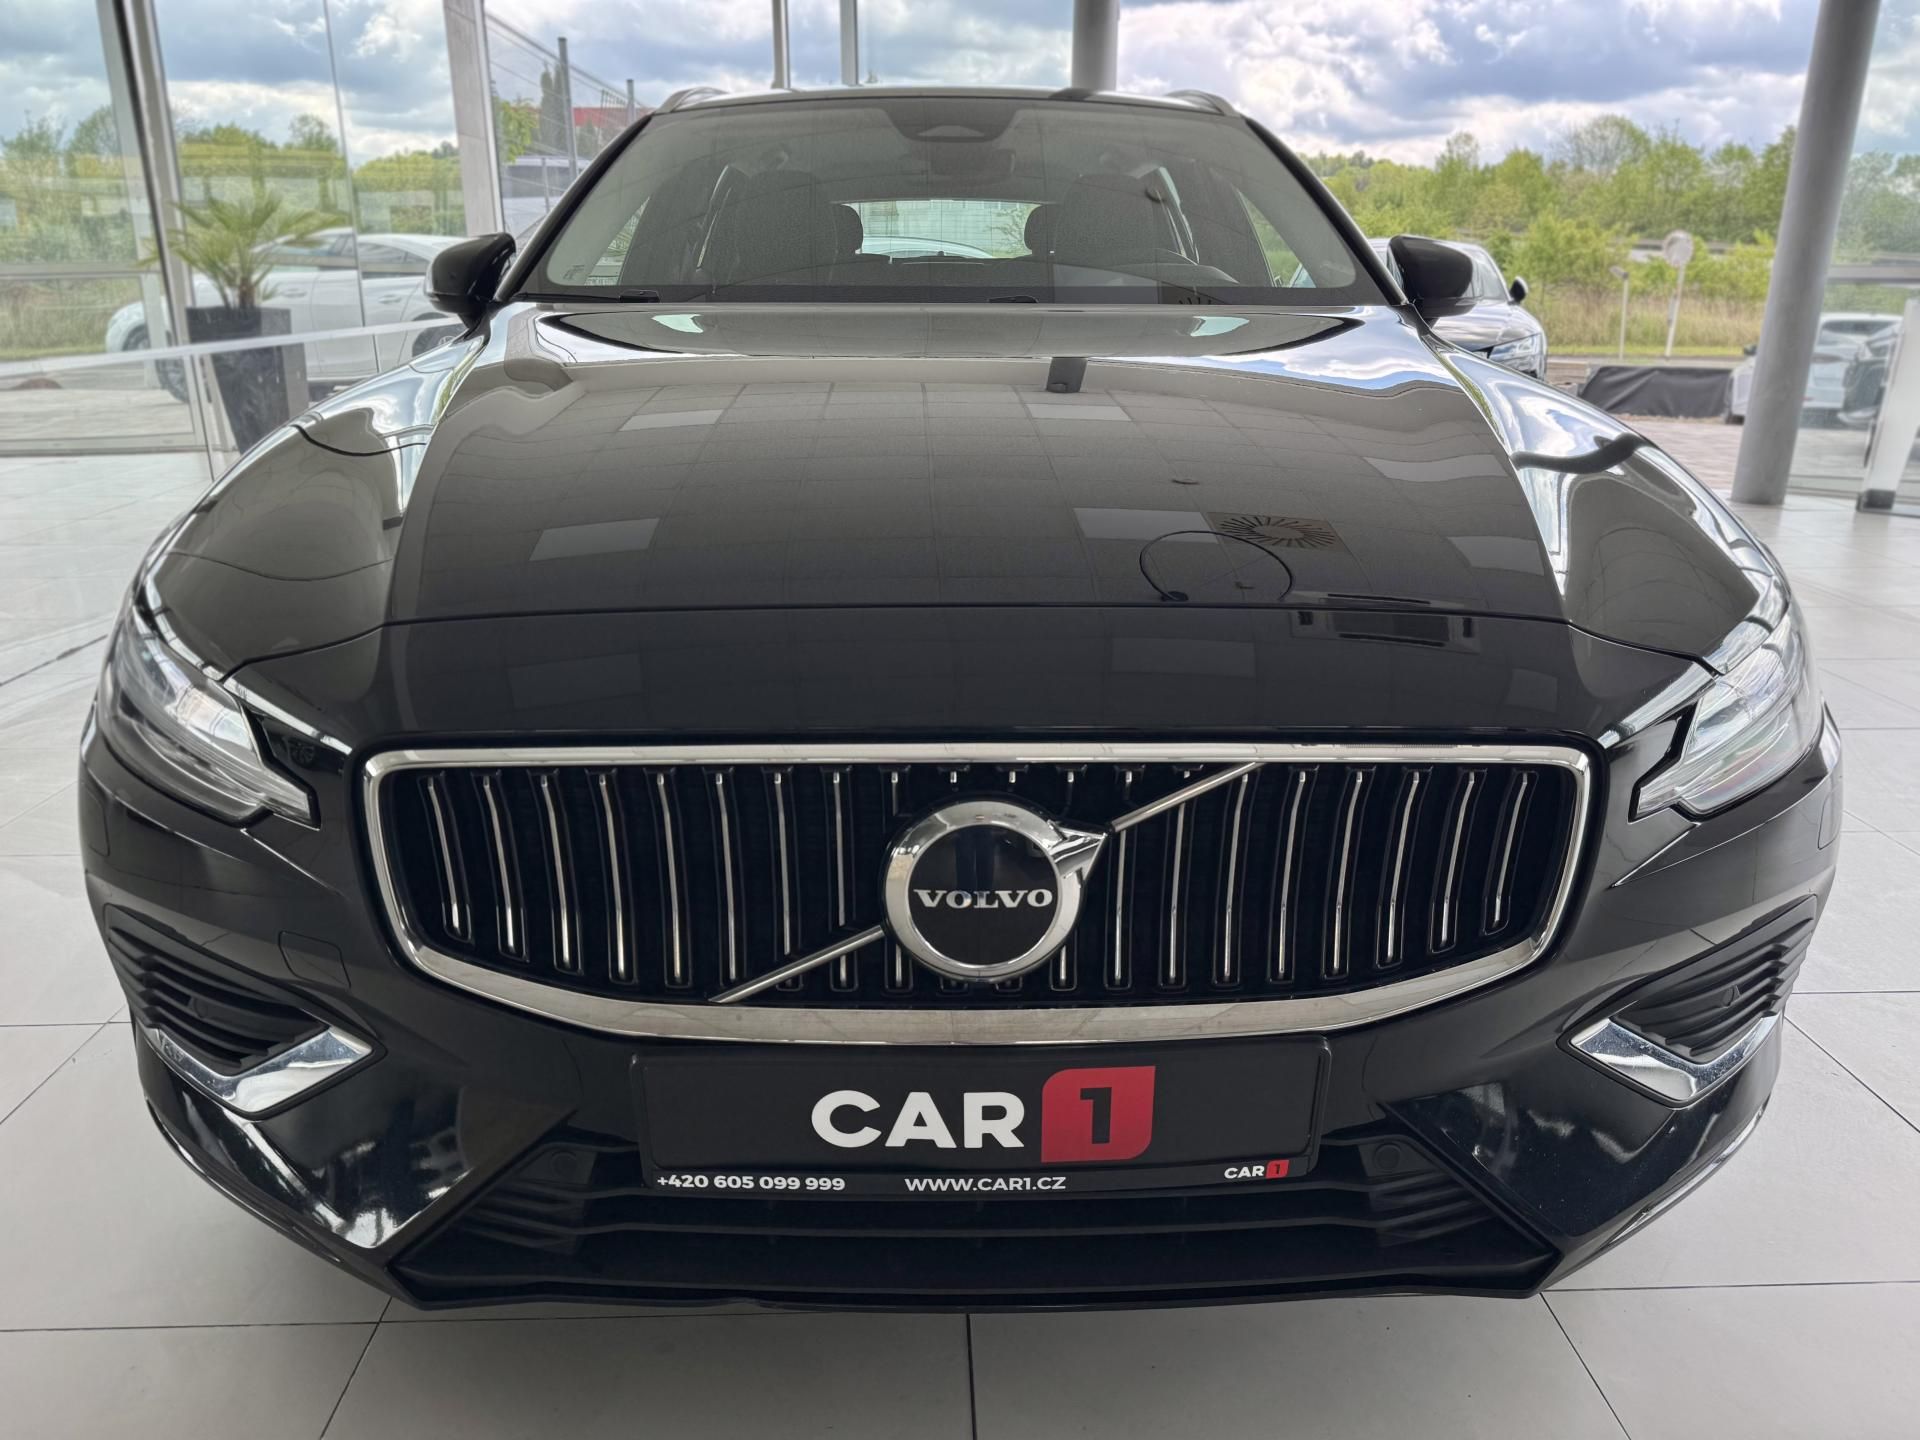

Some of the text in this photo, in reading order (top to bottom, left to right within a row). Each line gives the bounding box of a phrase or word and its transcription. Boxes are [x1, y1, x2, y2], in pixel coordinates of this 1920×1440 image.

[913, 888, 1053, 909] VOLVO
[811, 1086, 1113, 1149] CAR 1
[1223, 1165, 1265, 1179] CAR
[657, 1174, 846, 1191] +420 605 099 999
[904, 1176, 1067, 1192] WWW.CAR1.CZ
